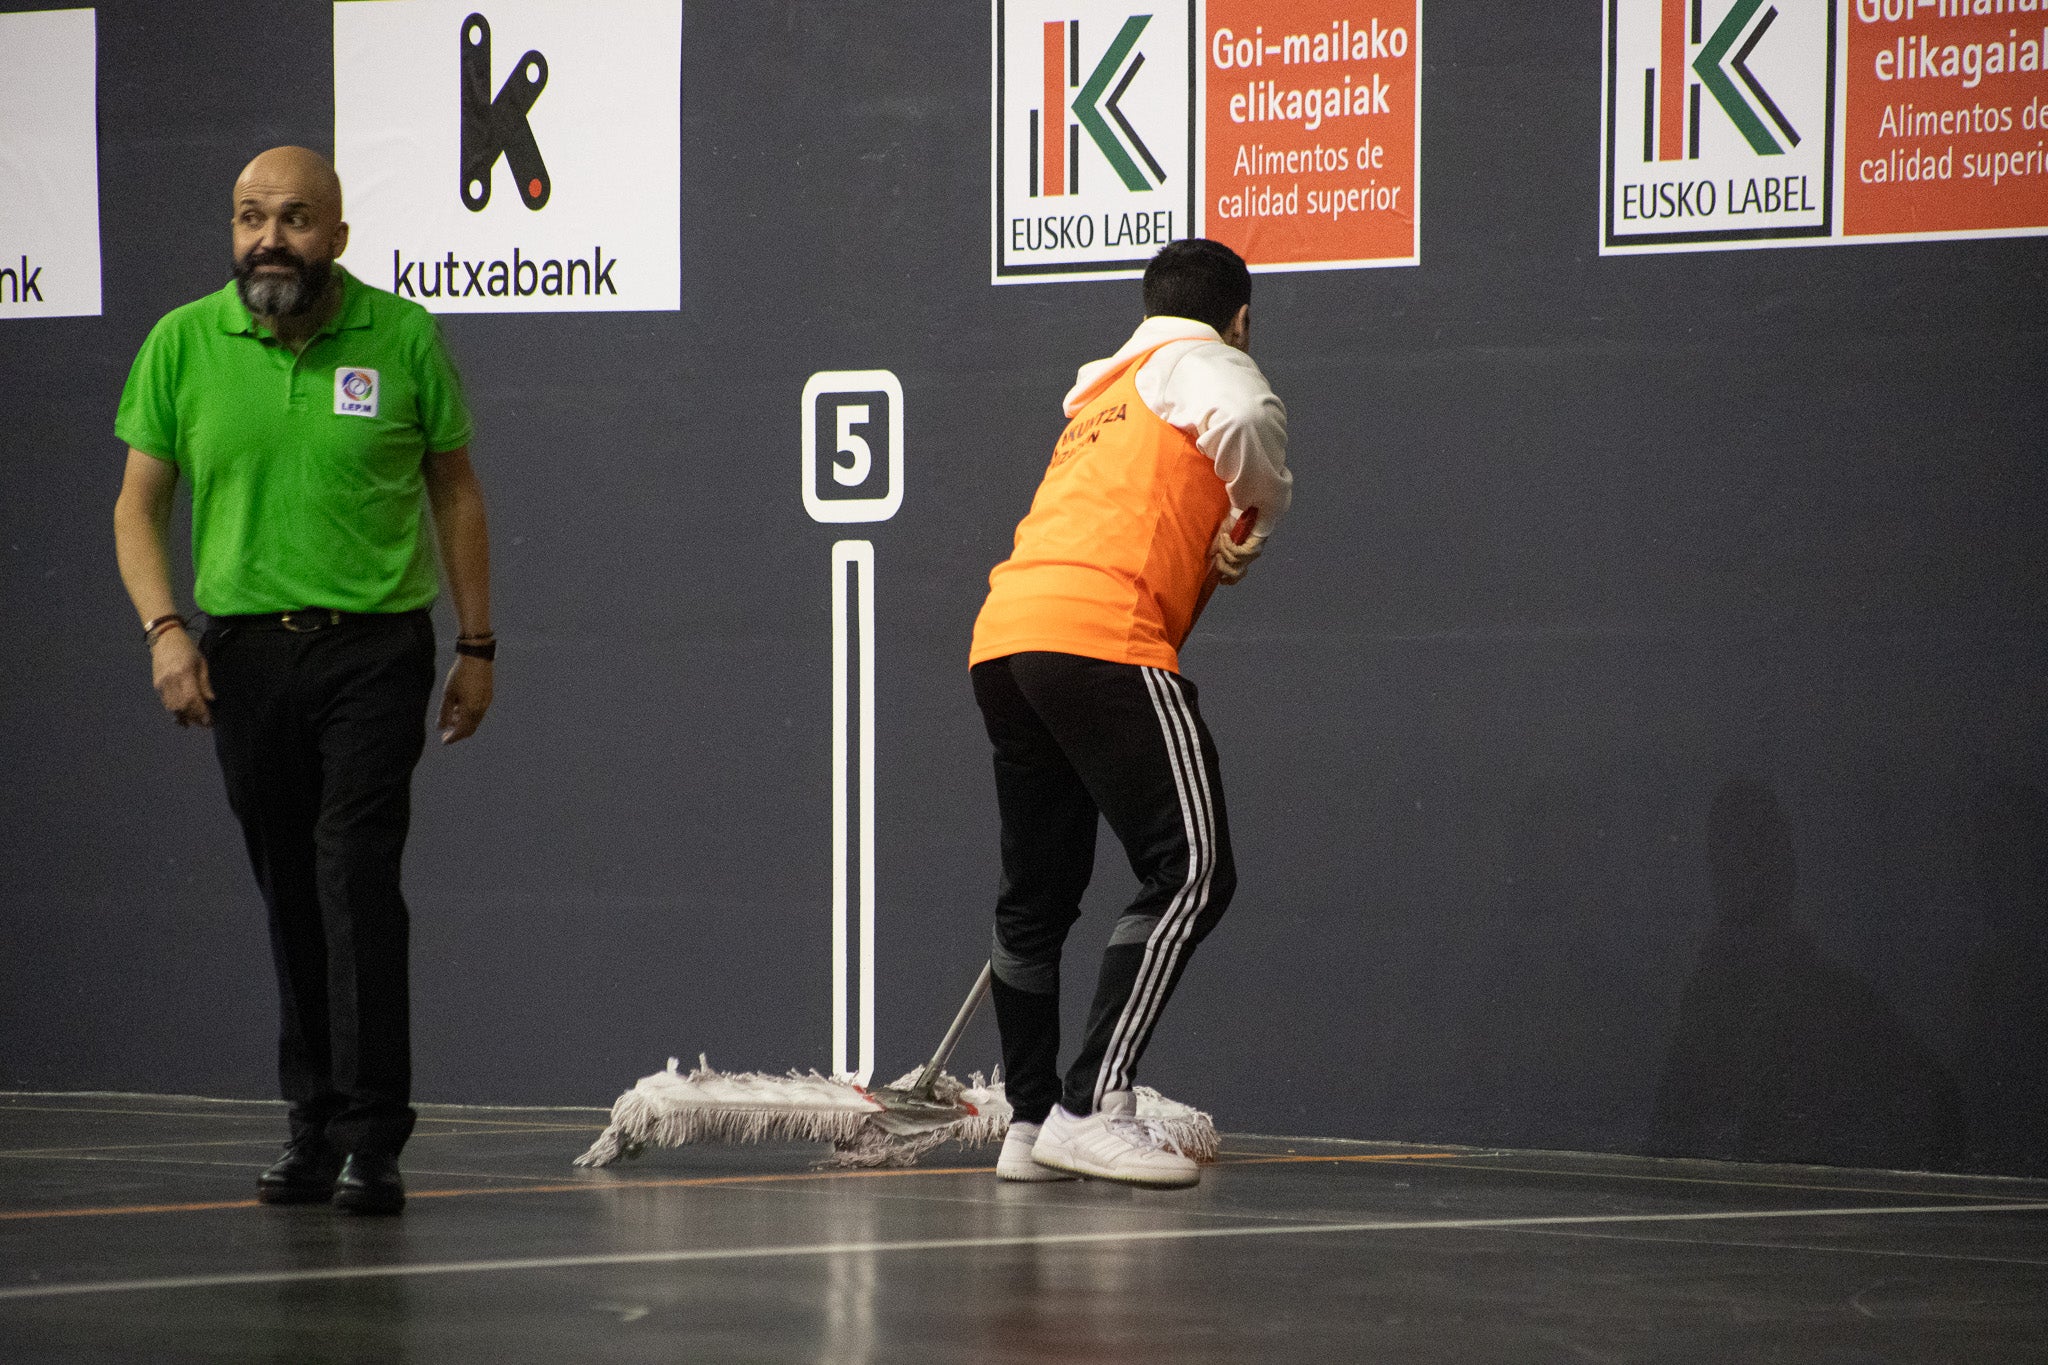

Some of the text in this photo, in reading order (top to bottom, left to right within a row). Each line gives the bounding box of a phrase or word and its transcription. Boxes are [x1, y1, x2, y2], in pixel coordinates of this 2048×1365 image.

[1212, 17, 1408, 69] Goi-mailako
[1229, 73, 1390, 130] elikagaiak
[1878, 96, 2048, 138] Alimentos de
[1233, 138, 1384, 176] Alimentos de
[1860, 140, 2048, 186] calidad superi
[1218, 179, 1401, 221] calidad superior
[1623, 175, 1815, 220] EUSKO LABEL
[1012, 211, 1173, 251] EUSKO LABEL
[394, 246, 618, 297] kutxabank
[833, 405, 871, 486] 5
